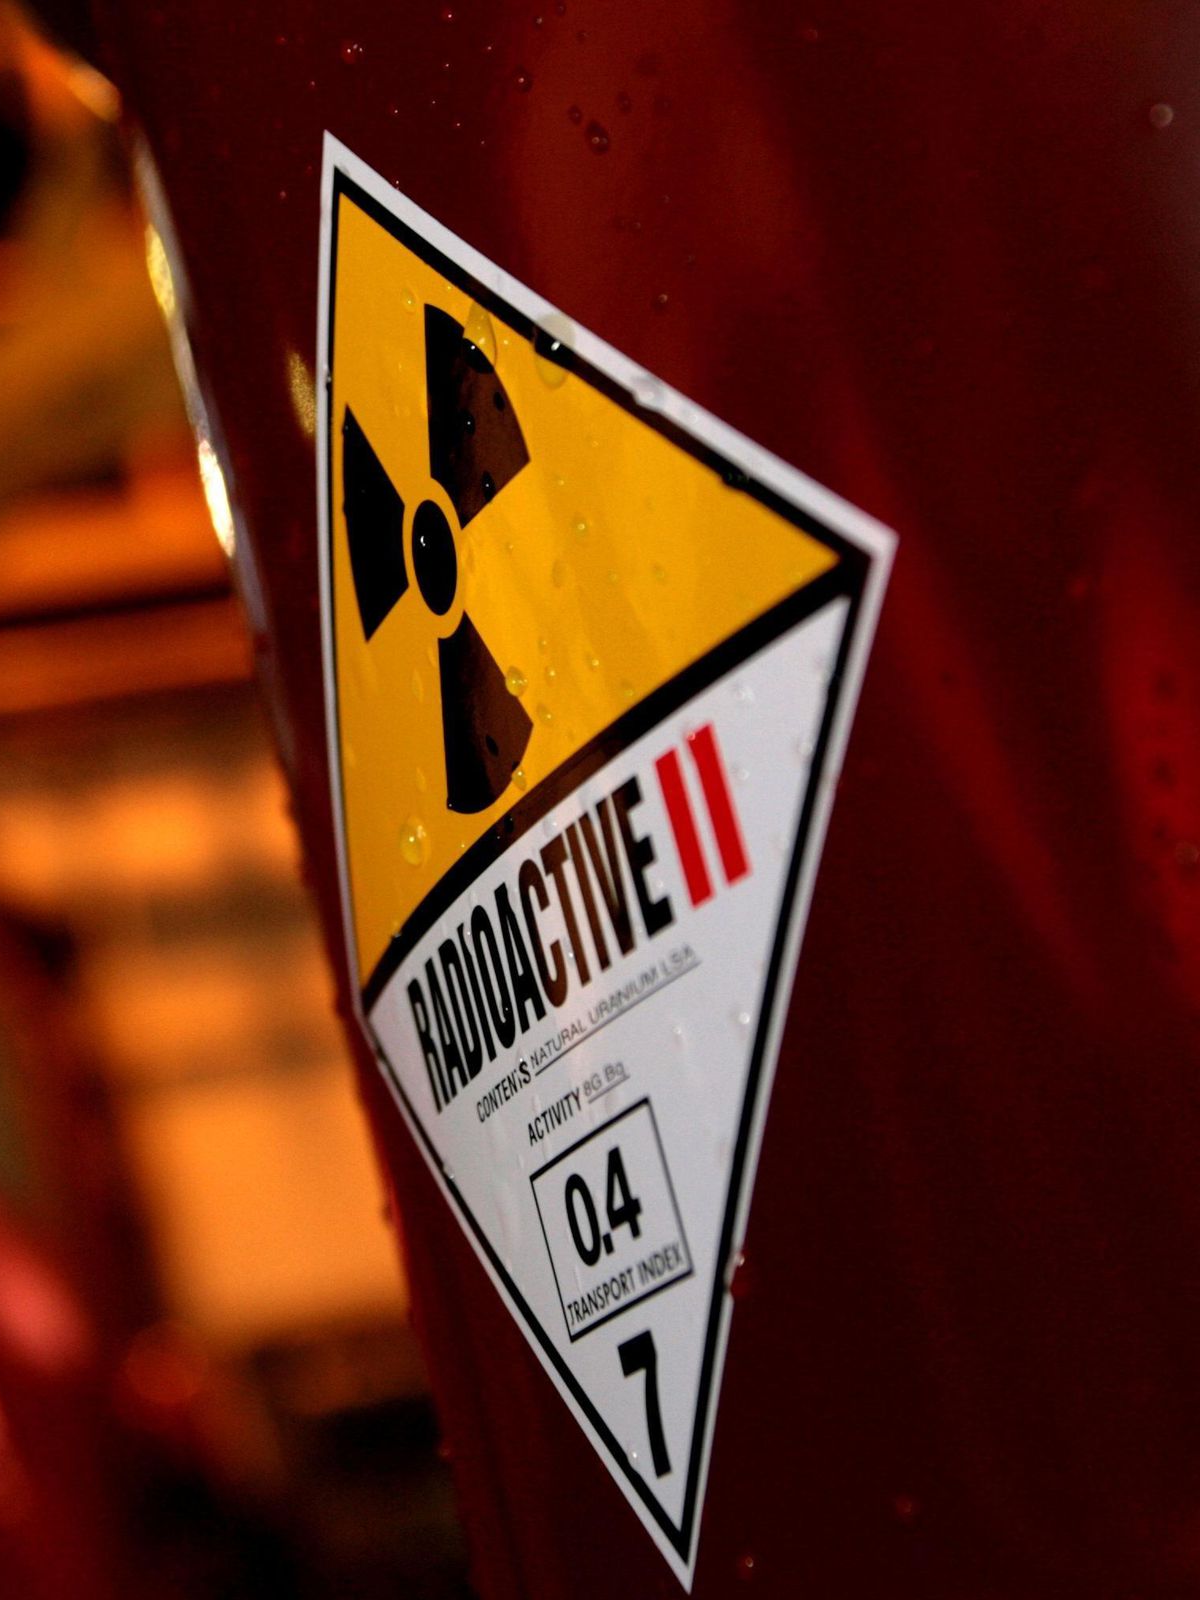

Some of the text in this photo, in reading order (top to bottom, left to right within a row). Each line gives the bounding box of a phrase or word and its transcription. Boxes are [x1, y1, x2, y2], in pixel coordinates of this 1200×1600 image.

[406, 722, 751, 1114] RADIOACTIVE II
[476, 1060, 531, 1123] CONTENTS
[530, 1022, 587, 1070] NATURAL
[589, 967, 658, 1024] URANIUM
[527, 1087, 582, 1146] ACTIVITY
[565, 1146, 642, 1266] 0.4
[567, 1242, 685, 1326] TRANSPORT INDEX
[617, 1330, 672, 1478] 7
